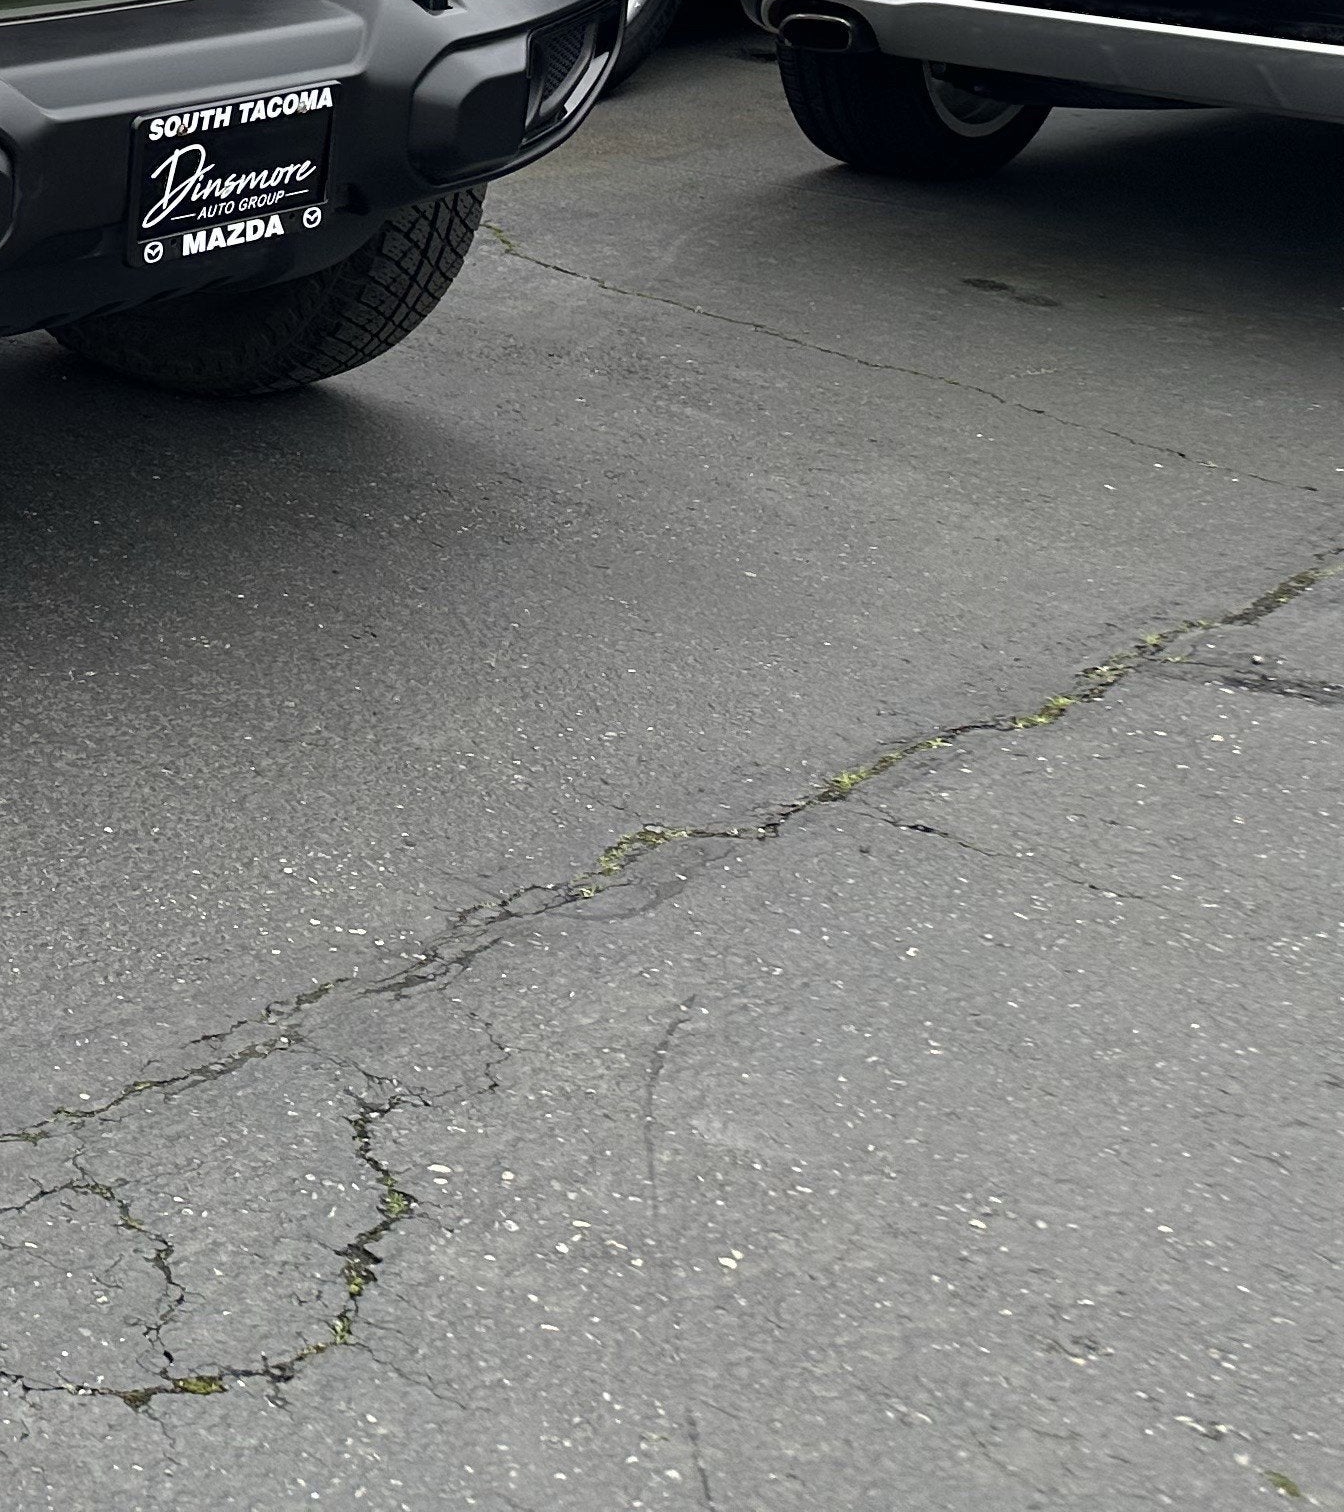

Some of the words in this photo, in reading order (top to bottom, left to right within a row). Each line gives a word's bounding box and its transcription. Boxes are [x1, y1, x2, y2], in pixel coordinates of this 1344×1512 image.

[148, 106, 233, 141] SOUTH
[239, 87, 333, 123] TACOMA
[142, 143, 317, 229] Dinsmore
[197, 200, 235, 221] AUTO
[238, 190, 285, 212] GROUP
[182, 215, 285, 256] MAZDA
